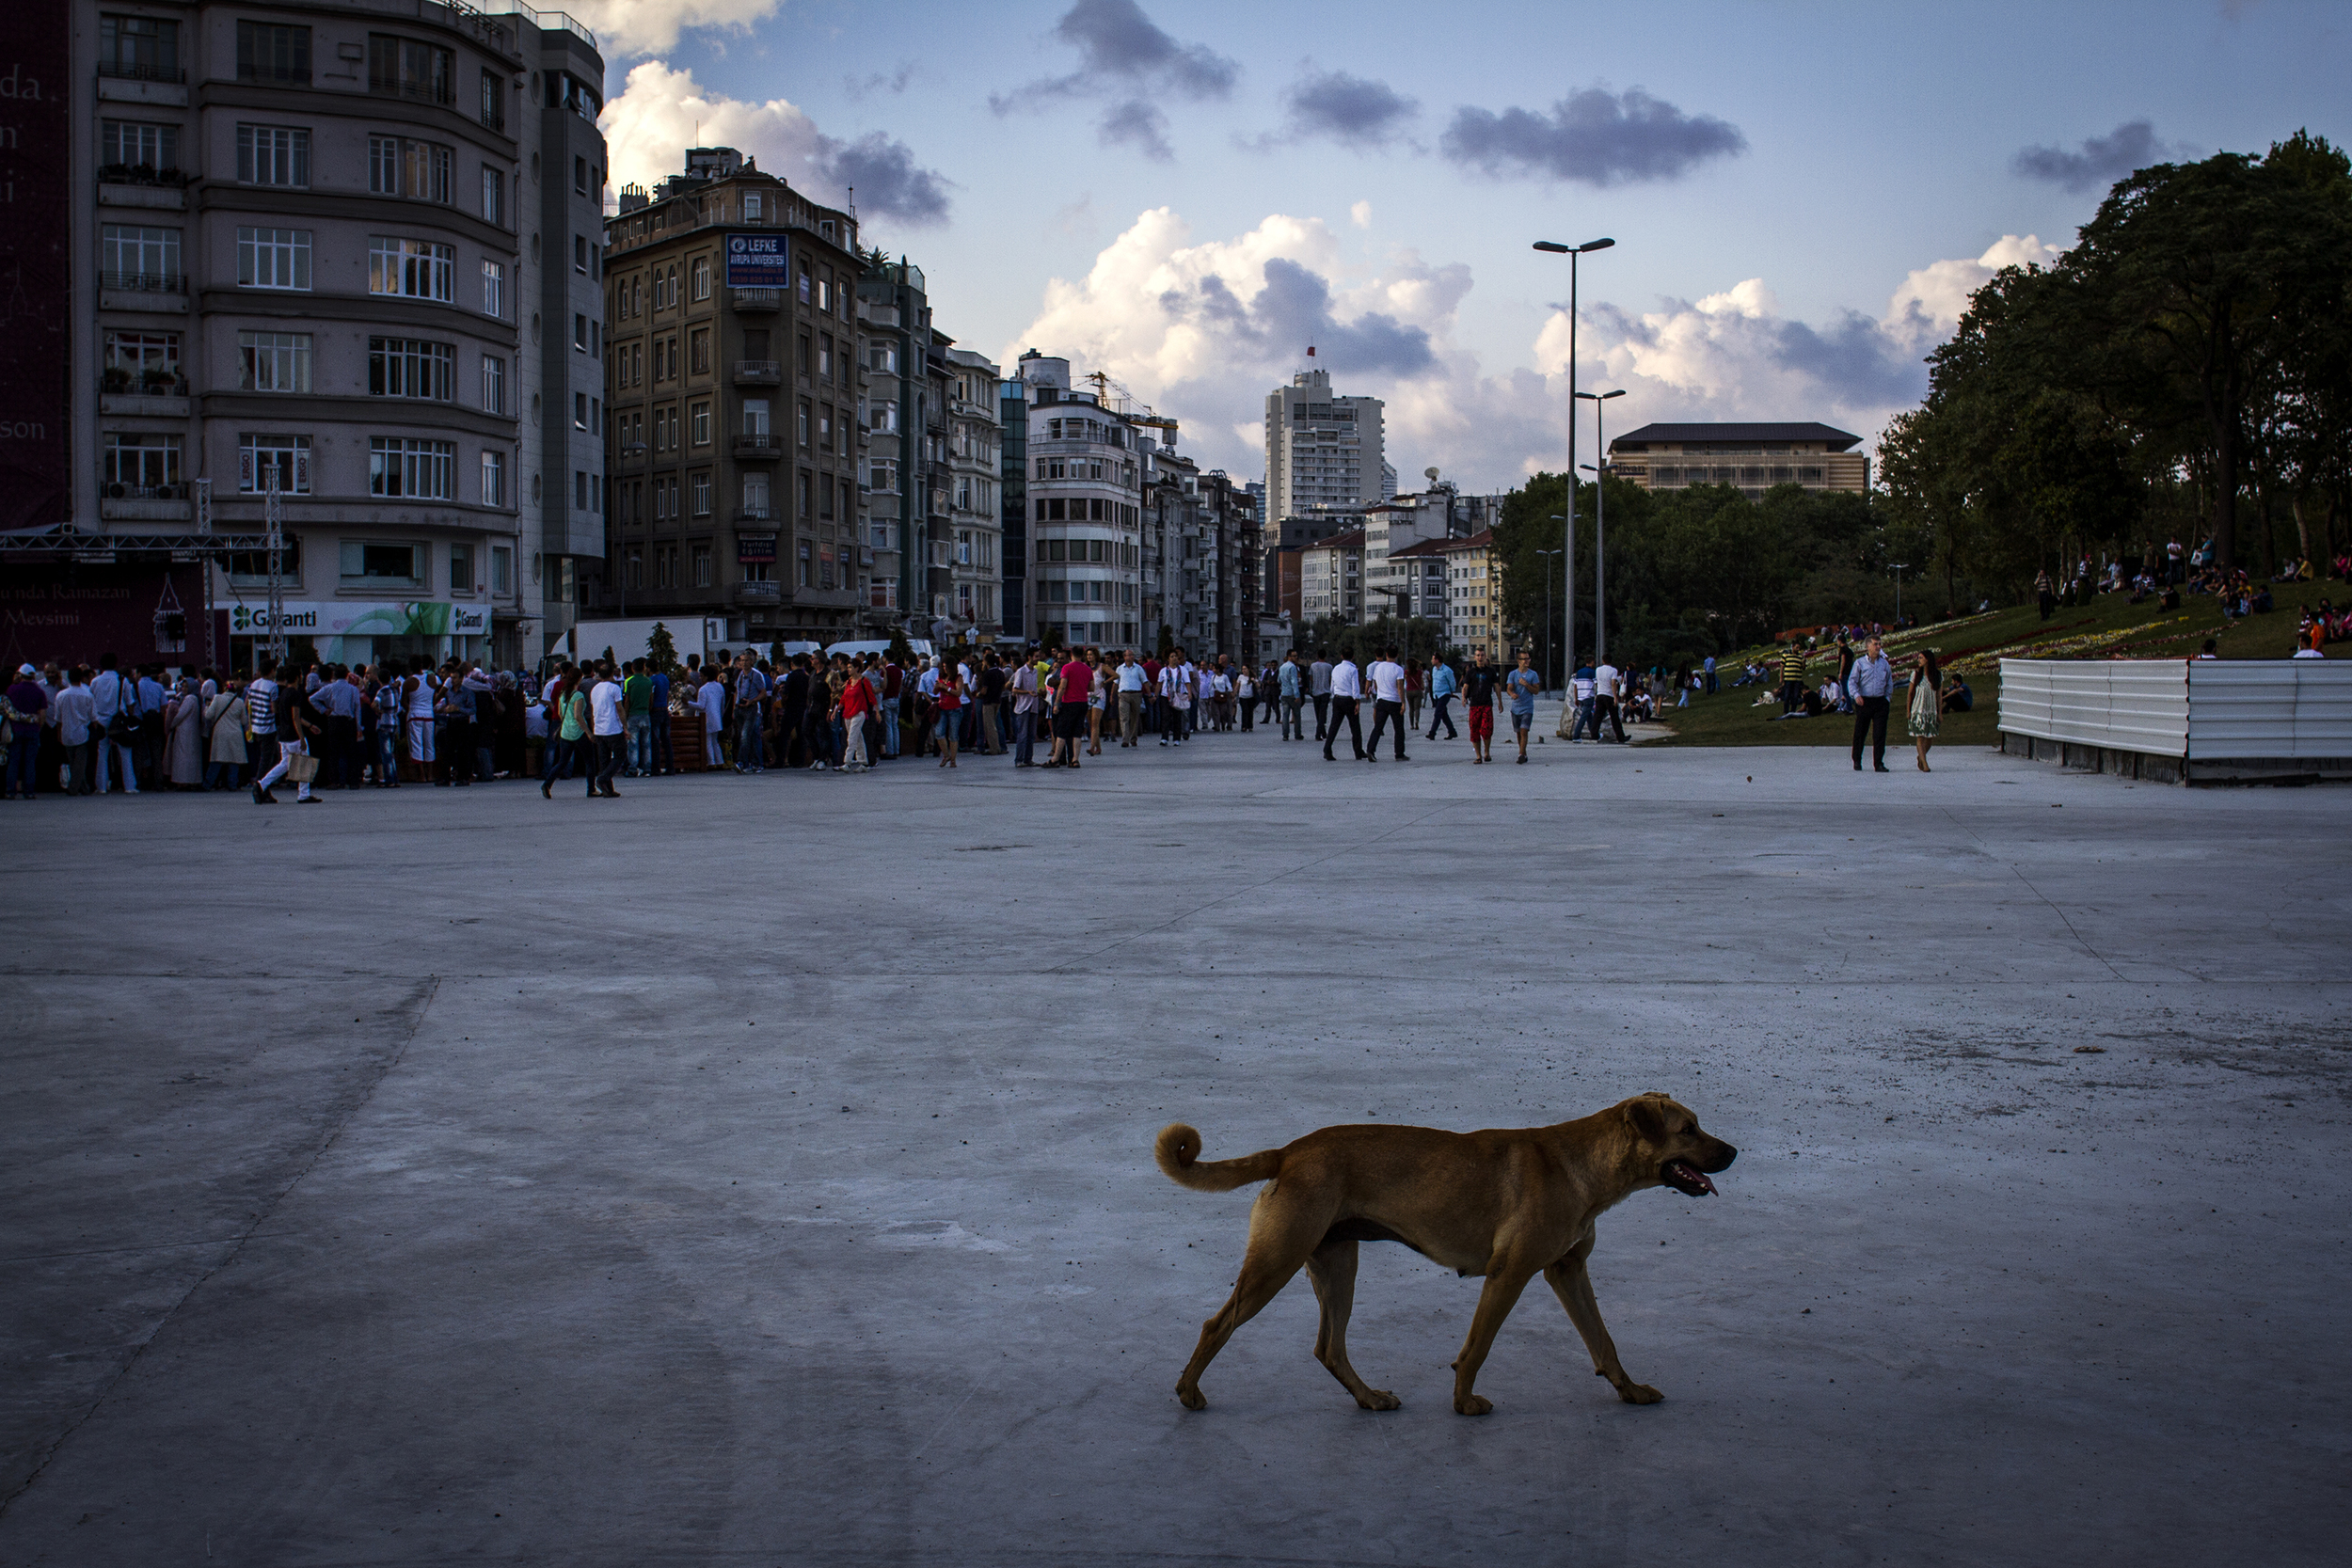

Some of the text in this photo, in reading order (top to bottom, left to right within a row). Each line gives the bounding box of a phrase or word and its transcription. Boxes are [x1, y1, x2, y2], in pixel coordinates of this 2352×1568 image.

[748, 239, 777, 252] LEFKE
[730, 254, 750, 265] AVRUPA
[0, 420, 45, 440] son
[242, 454, 250, 479] ERGO
[298, 457, 307, 483] ERGO
[52, 583, 132, 600] Ramazan
[2, 609, 80, 629] Mevsimi
[251, 610, 316, 626] Gaanti
